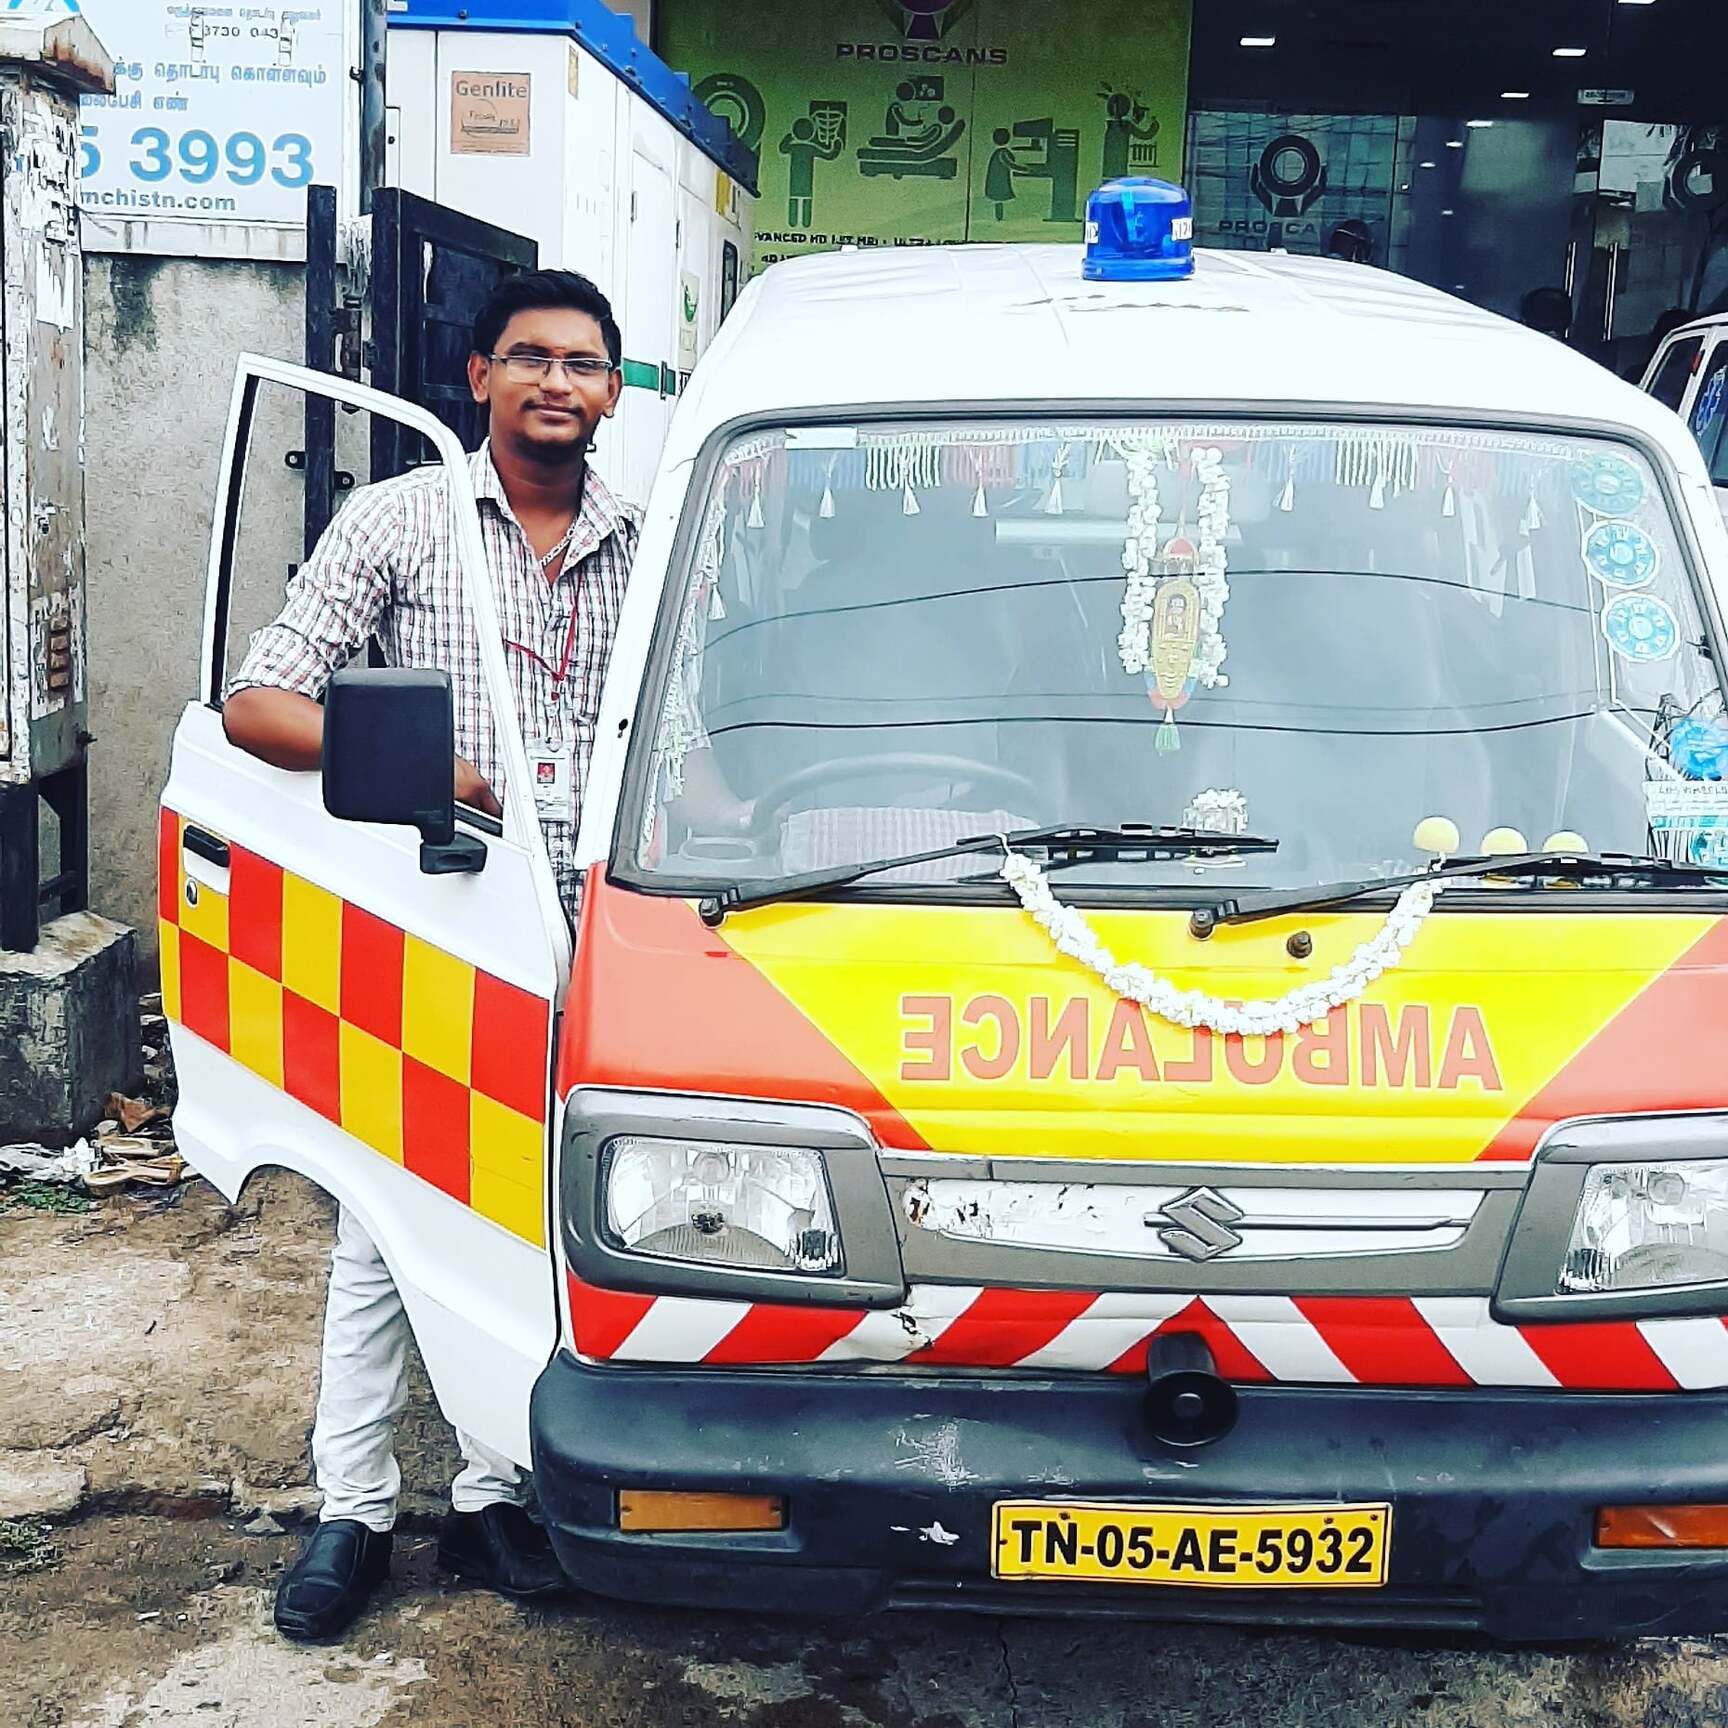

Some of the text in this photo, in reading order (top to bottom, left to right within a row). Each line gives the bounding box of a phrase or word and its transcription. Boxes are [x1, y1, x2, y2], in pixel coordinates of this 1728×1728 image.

[836, 43, 1008, 64] PROSCANS
[456, 80, 527, 98] Genlite
[129, 127, 314, 189] 3993
[754, 232, 807, 244] VANCED
[1012, 1519, 1375, 1574] TN-05-AE-5932
